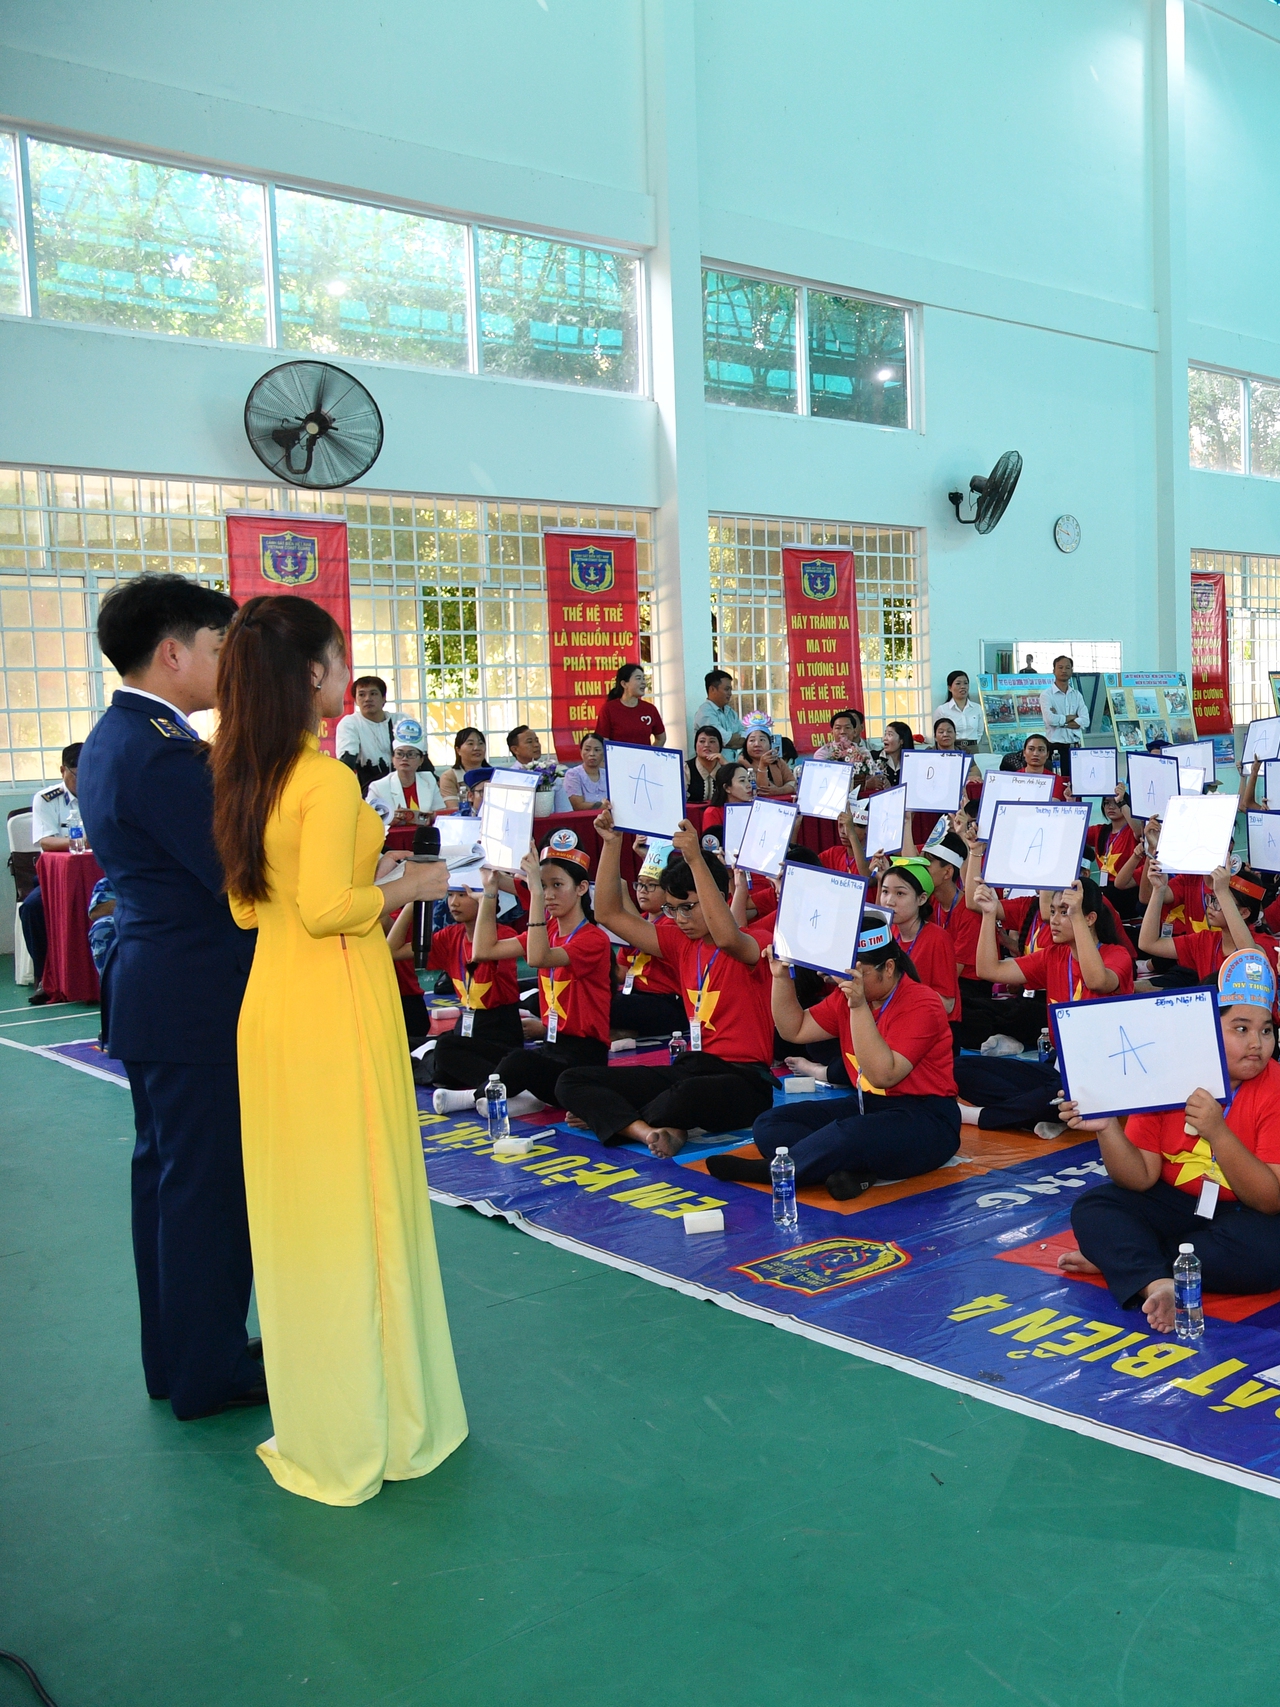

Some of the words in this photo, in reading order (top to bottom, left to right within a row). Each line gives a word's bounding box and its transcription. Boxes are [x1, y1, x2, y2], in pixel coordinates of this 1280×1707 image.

[563, 603, 583, 622] THẾ
[586, 604, 600, 625] HỆ
[603, 603, 623, 622] TRẺ
[791, 613, 807, 629] HÃY
[810, 613, 836, 629] TRÁNH
[838, 616, 849, 629] XA
[554, 629, 568, 646] LÀ
[571, 627, 610, 646] NGUỒN
[613, 630, 633, 649] LỰC
[806, 639, 820, 653] MA
[822, 636, 836, 653] TÚY
[563, 654, 592, 671] PHÁT
[796, 660, 805, 677] VÌ
[807, 662, 834, 677] TƯƠNG
[836, 662, 849, 676] LAI
[575, 681, 601, 695] KINH
[800, 682, 816, 700] THẾ
[818, 685, 829, 702] HỆ
[831, 681, 849, 701] TRẺ,
[1203, 688, 1224, 700] CƯƠNG
[797, 707, 806, 725] VÌ
[808, 709, 831, 727] HẠNH
[1204, 706, 1220, 717] QUỐC
[1254, 729, 1269, 753] A
[927, 766, 934, 779] D
[629, 764, 664, 810] A
[1024, 827, 1043, 865] A
[1268, 832, 1276, 848] A
[810, 909, 821, 929] A
[869, 935, 883, 946] TIM
[1108, 1025, 1156, 1075] A
[521, 1154, 641, 1194] YÊU
[608, 1181, 730, 1220] EM
[947, 1293, 1012, 1322] 4
[988, 1306, 1199, 1378] BIỂN
